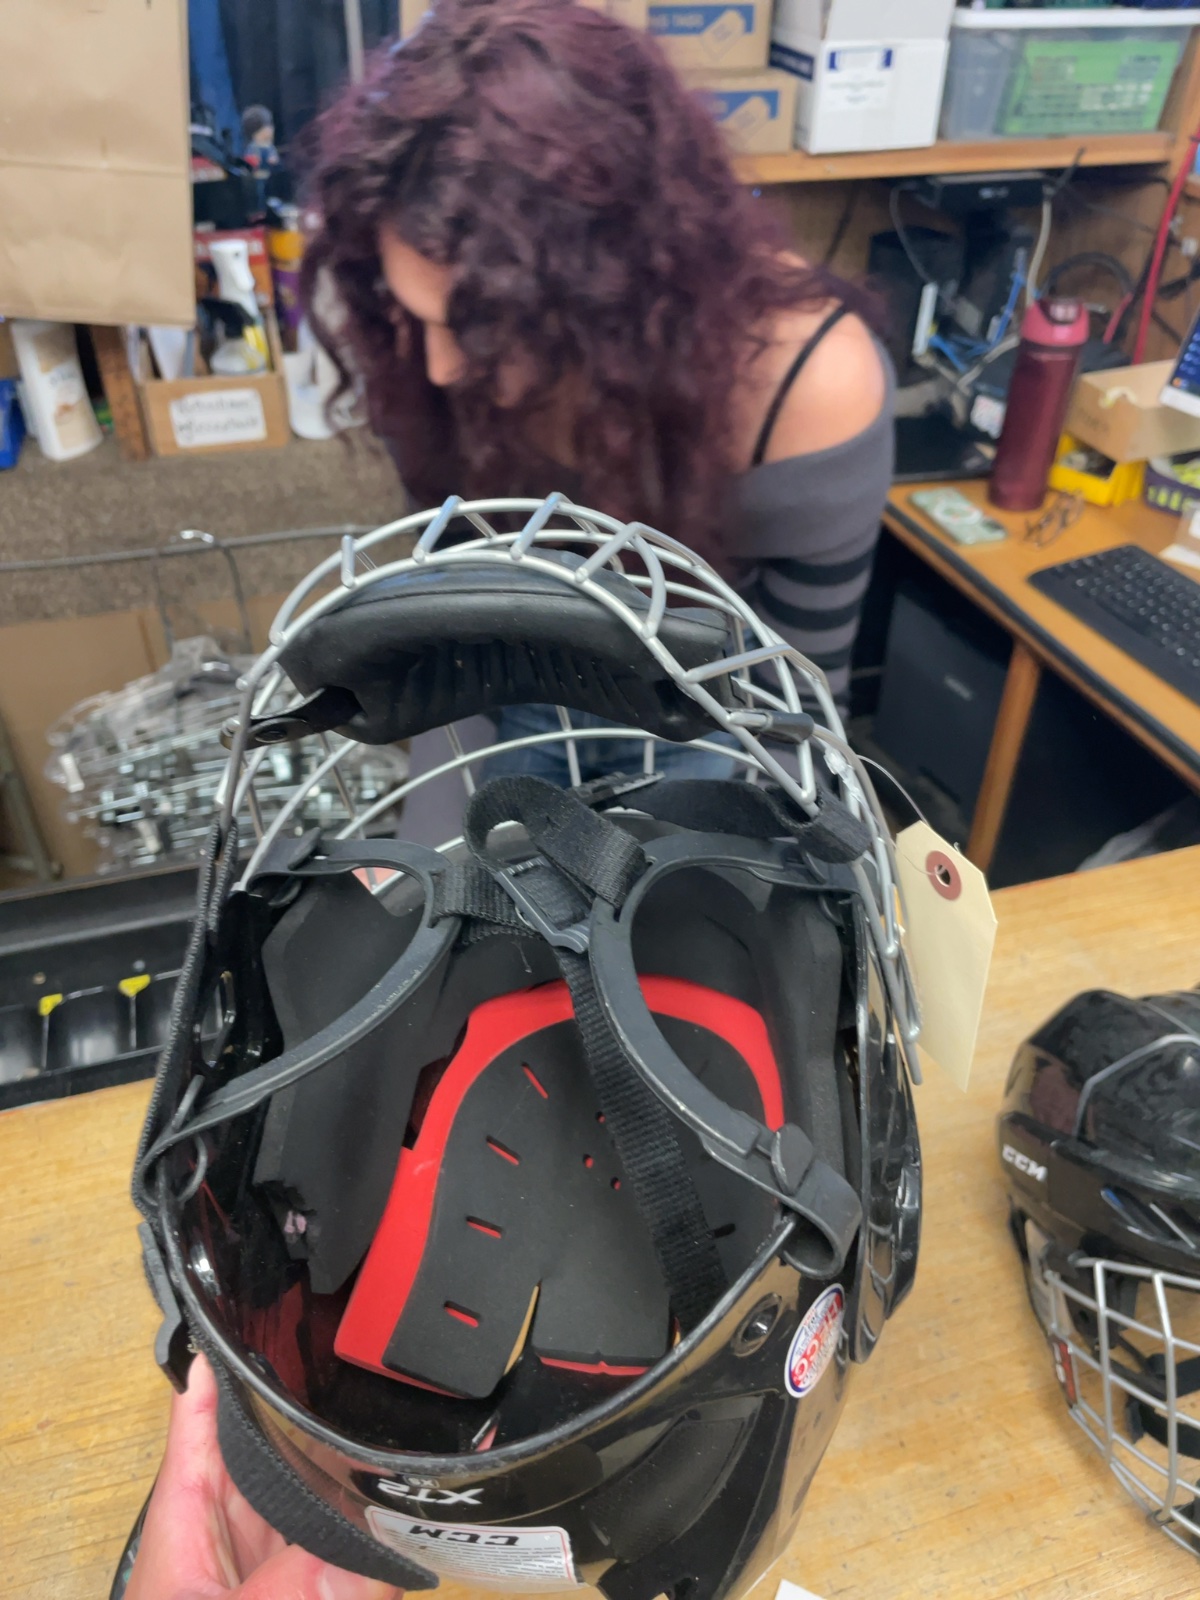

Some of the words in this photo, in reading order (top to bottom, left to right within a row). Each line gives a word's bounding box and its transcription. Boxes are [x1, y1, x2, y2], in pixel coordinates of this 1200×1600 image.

[1002, 1143, 1048, 1182] CCM
[377, 1478, 485, 1505] XT2
[409, 1525, 520, 1546] CCM
